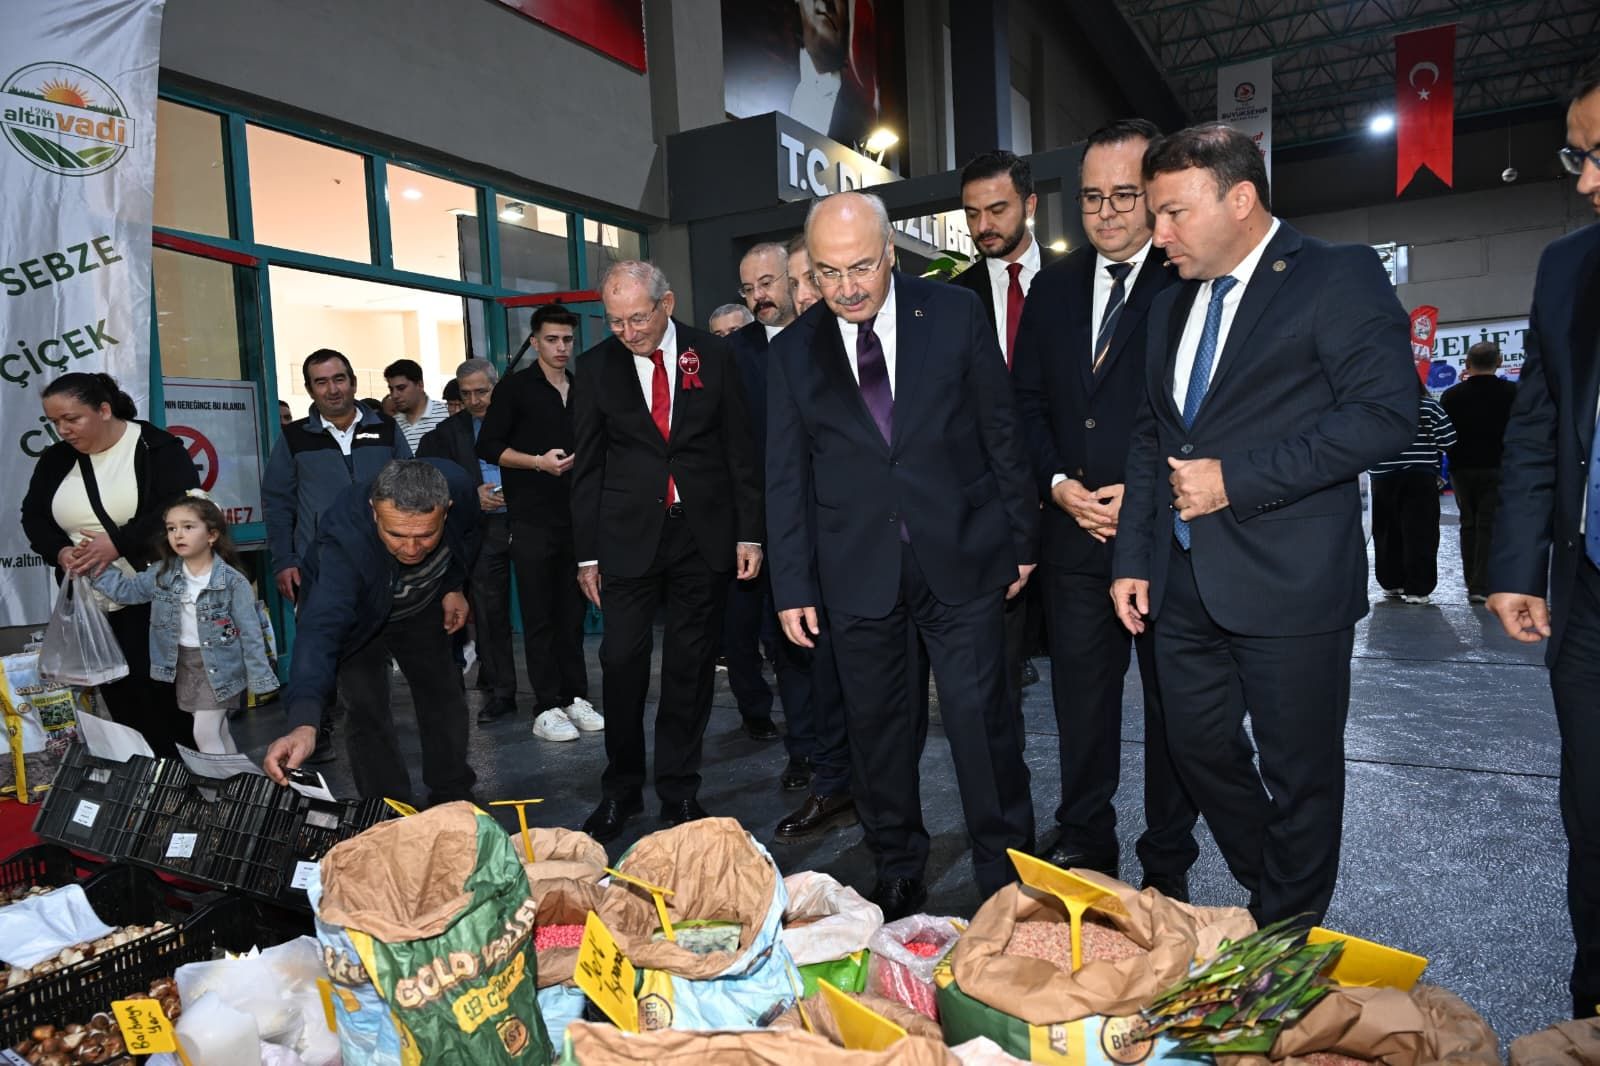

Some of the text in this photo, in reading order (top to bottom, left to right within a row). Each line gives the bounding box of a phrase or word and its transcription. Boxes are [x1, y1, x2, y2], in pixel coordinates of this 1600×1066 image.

[0, 236, 122, 296] SEBZE
[0, 319, 119, 388] ÇİÇEK
[213, 402, 220, 410] BU
[222, 402, 246, 411] ALANDA
[395, 952, 478, 1010] GOLD
[1111, 1026, 1144, 1050] BES
